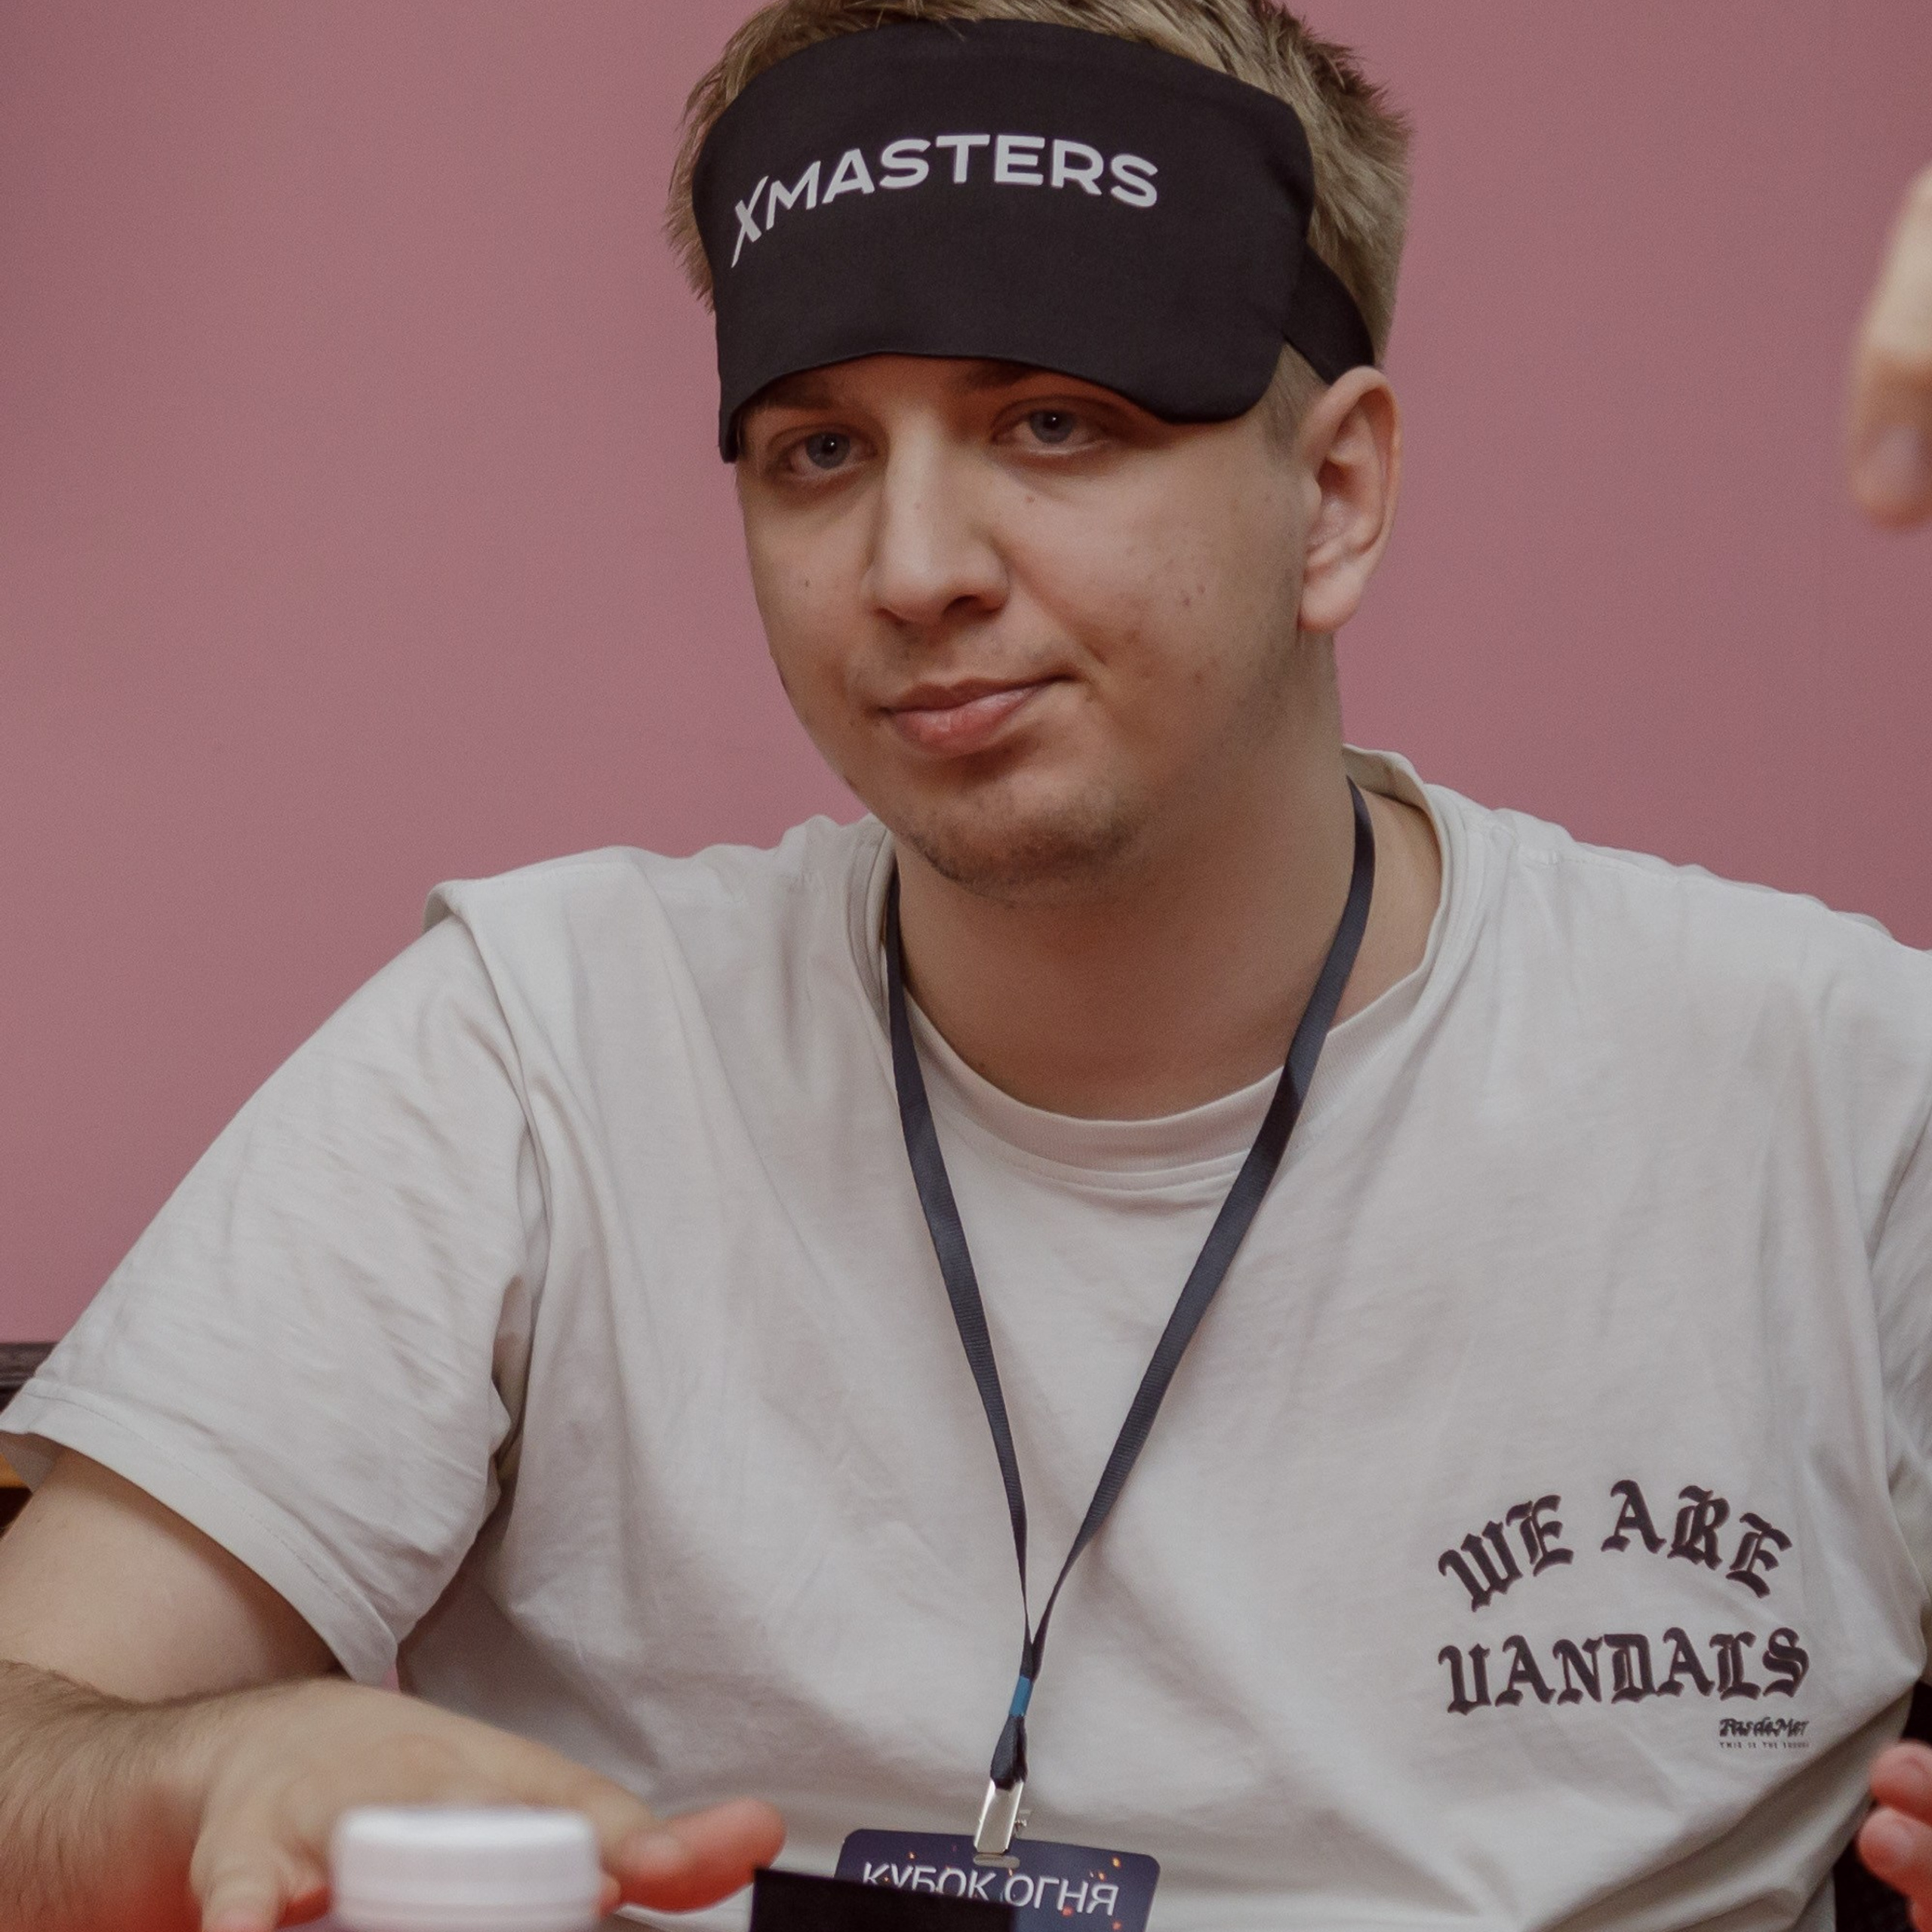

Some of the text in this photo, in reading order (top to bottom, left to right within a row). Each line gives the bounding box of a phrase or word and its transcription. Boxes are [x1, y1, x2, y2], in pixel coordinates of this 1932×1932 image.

[731, 133, 1159, 269] XMASTERS
[1438, 1479, 1793, 1613] WE ARE
[1004, 1873, 1120, 1916] ОГНЯ
